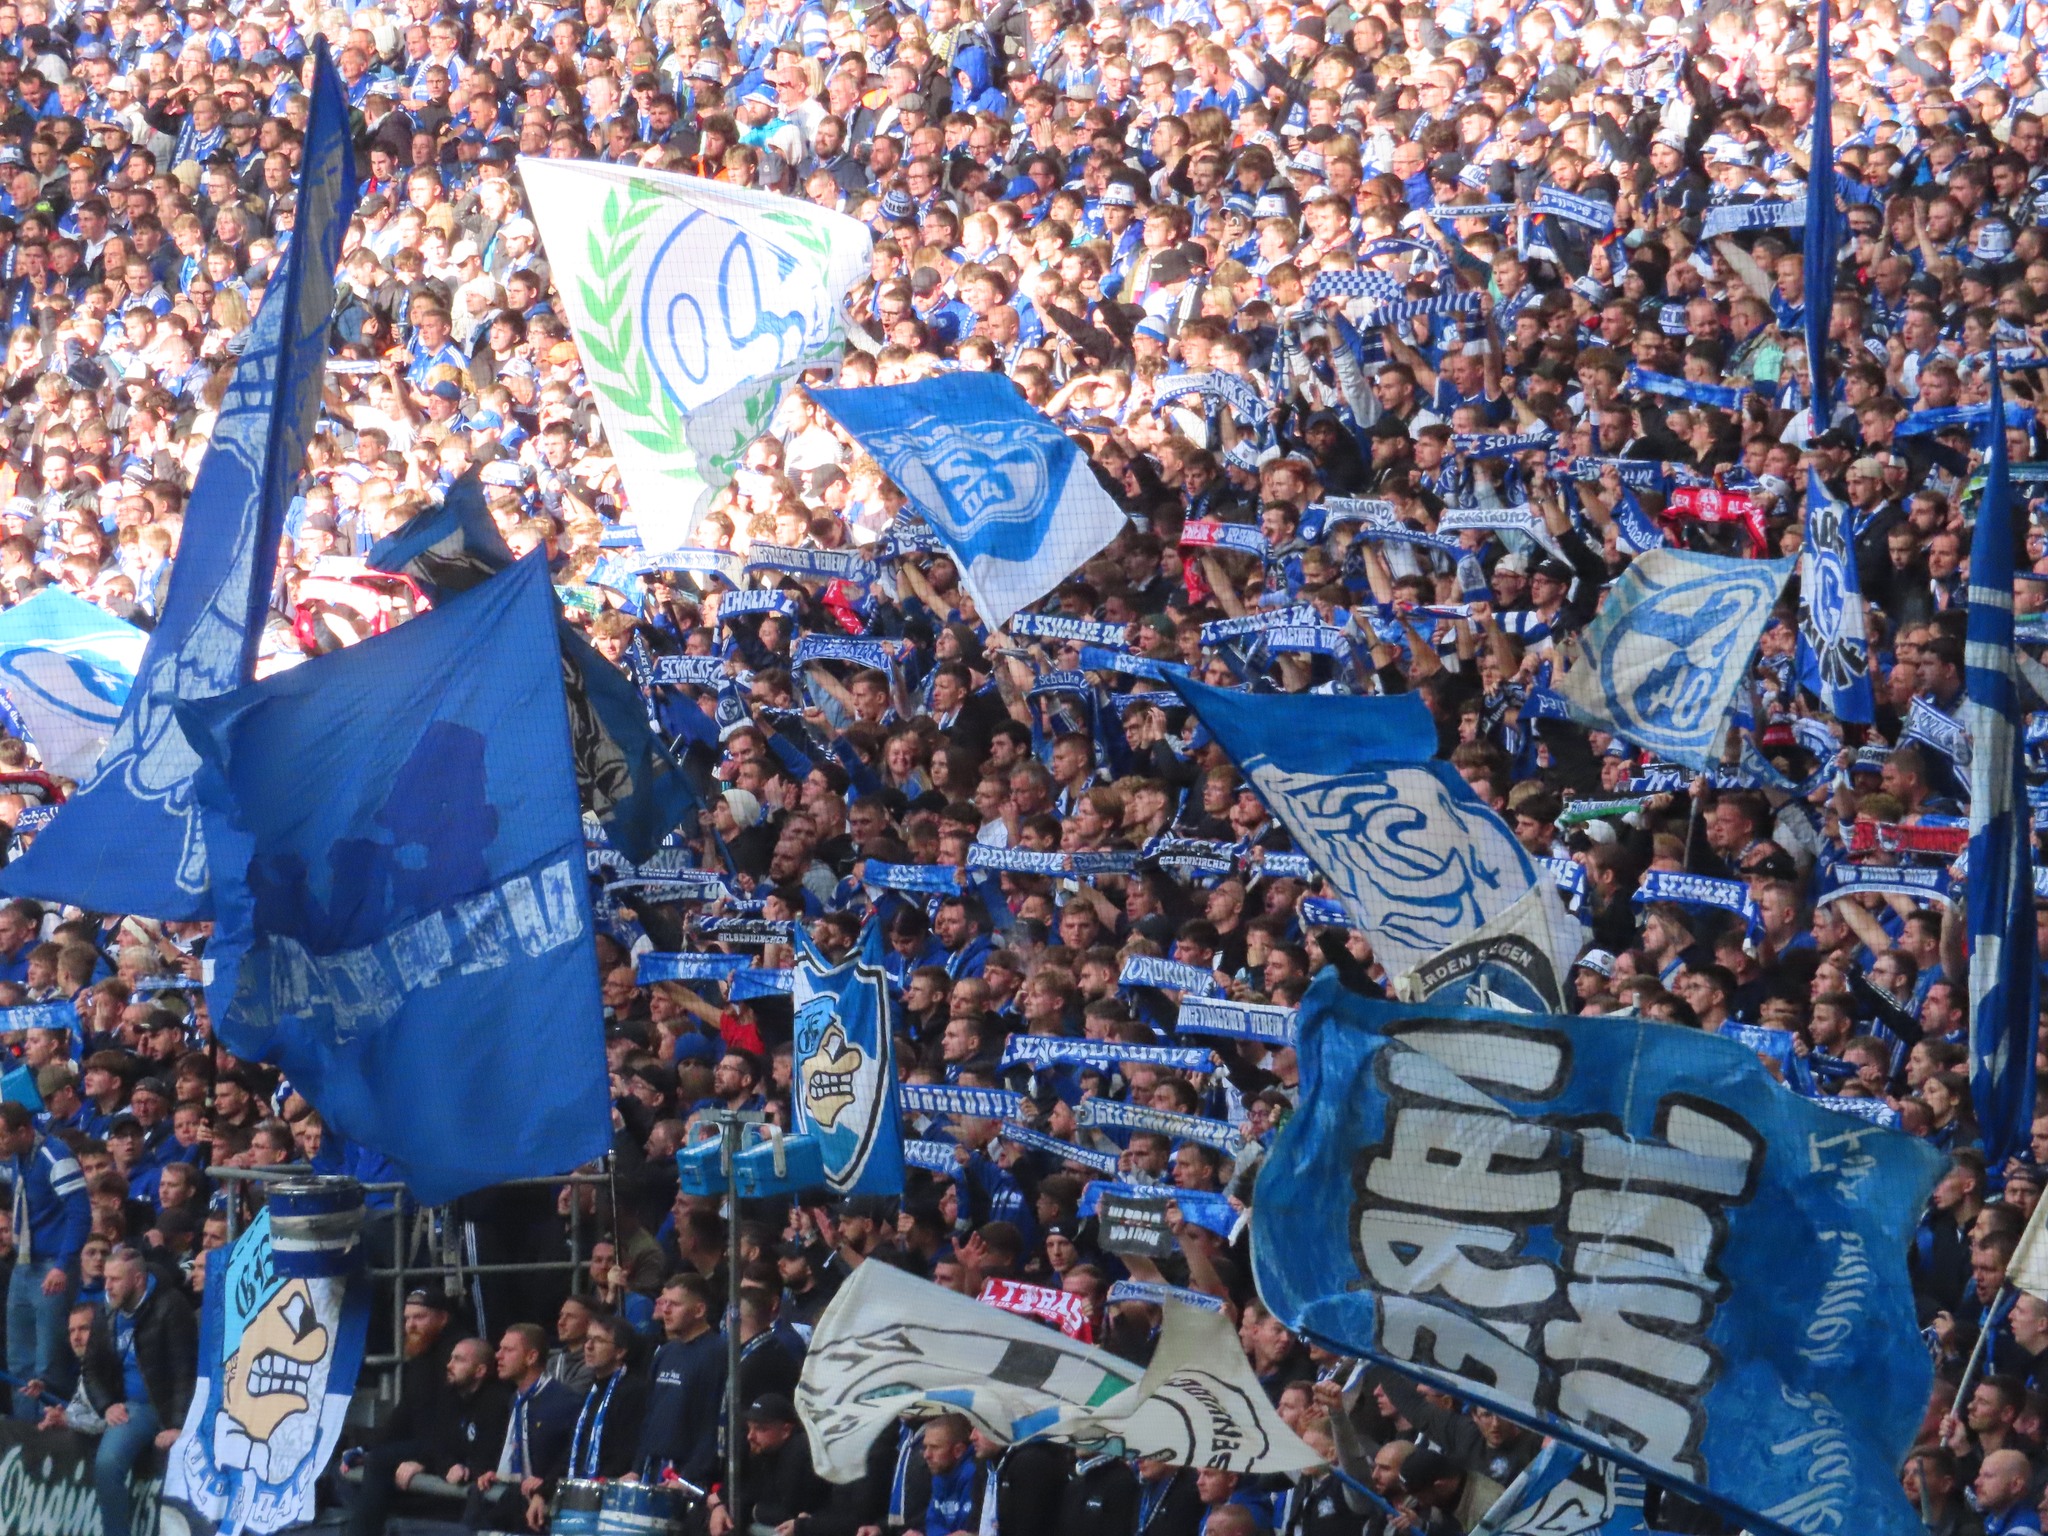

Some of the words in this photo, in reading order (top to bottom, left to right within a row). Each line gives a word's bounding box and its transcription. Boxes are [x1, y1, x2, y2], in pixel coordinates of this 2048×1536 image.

[1012, 616, 1032, 635] FC
[1034, 618, 1101, 643] SCHALKE
[1101, 626, 1125, 646] 04
[1039, 674, 1080, 685] Schalke
[17, 804, 59, 828] Schal
[967, 843, 1065, 873] ORDKURVE
